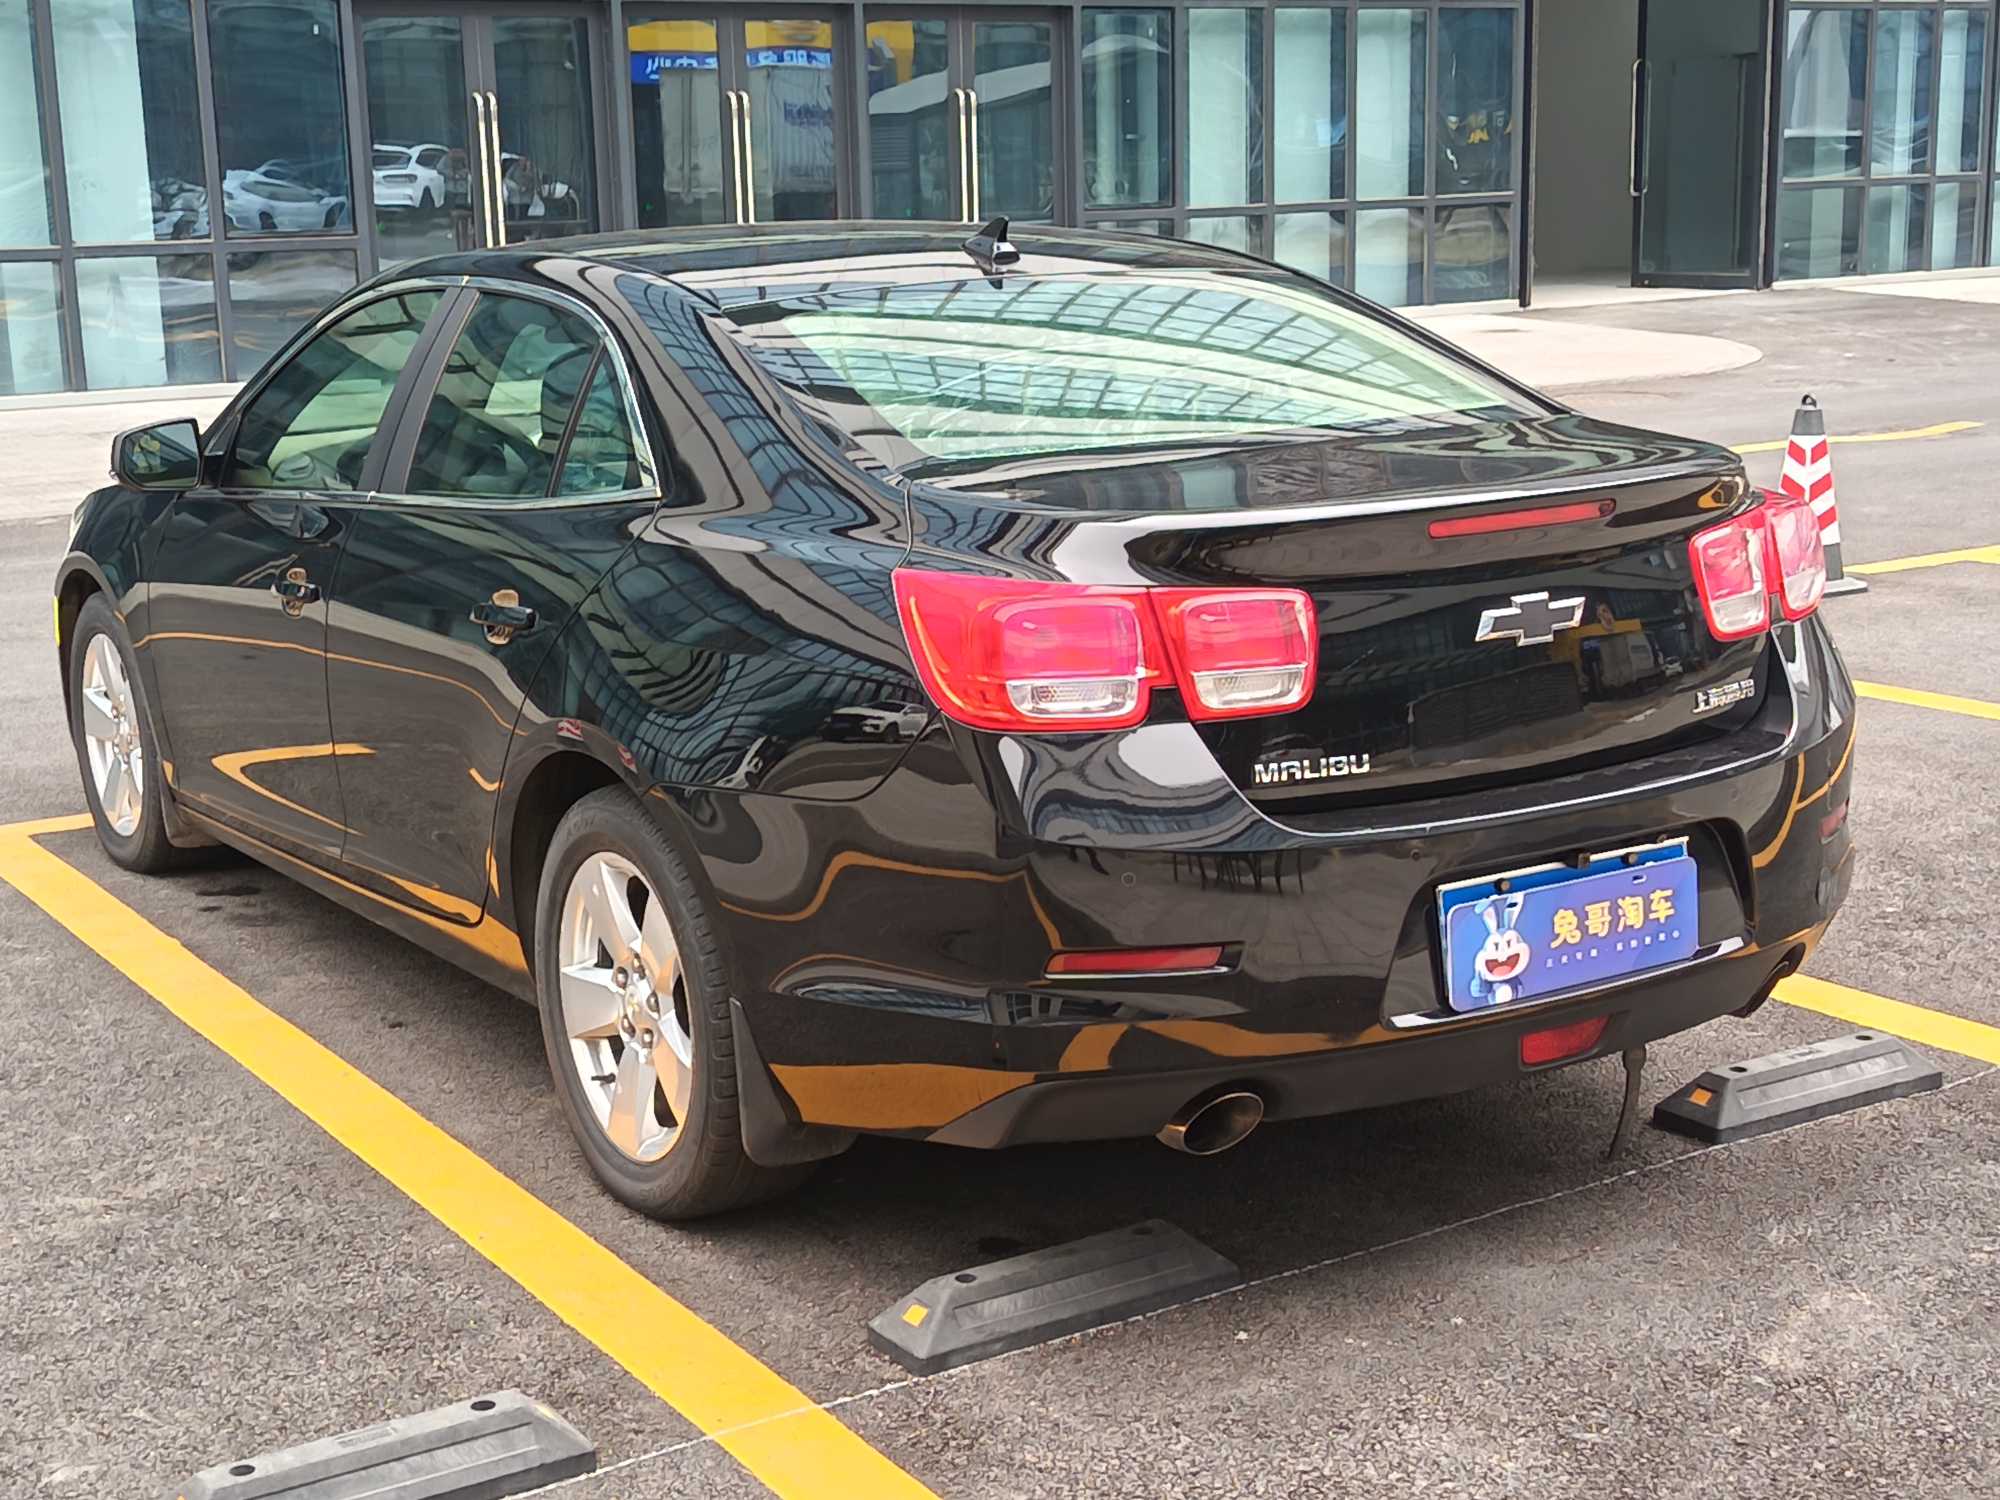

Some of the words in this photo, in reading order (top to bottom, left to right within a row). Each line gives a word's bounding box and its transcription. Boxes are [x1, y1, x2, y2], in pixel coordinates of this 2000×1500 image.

[1254, 753, 1371, 784] MALIBU
[1550, 889, 1675, 949] 兔哥淘车
